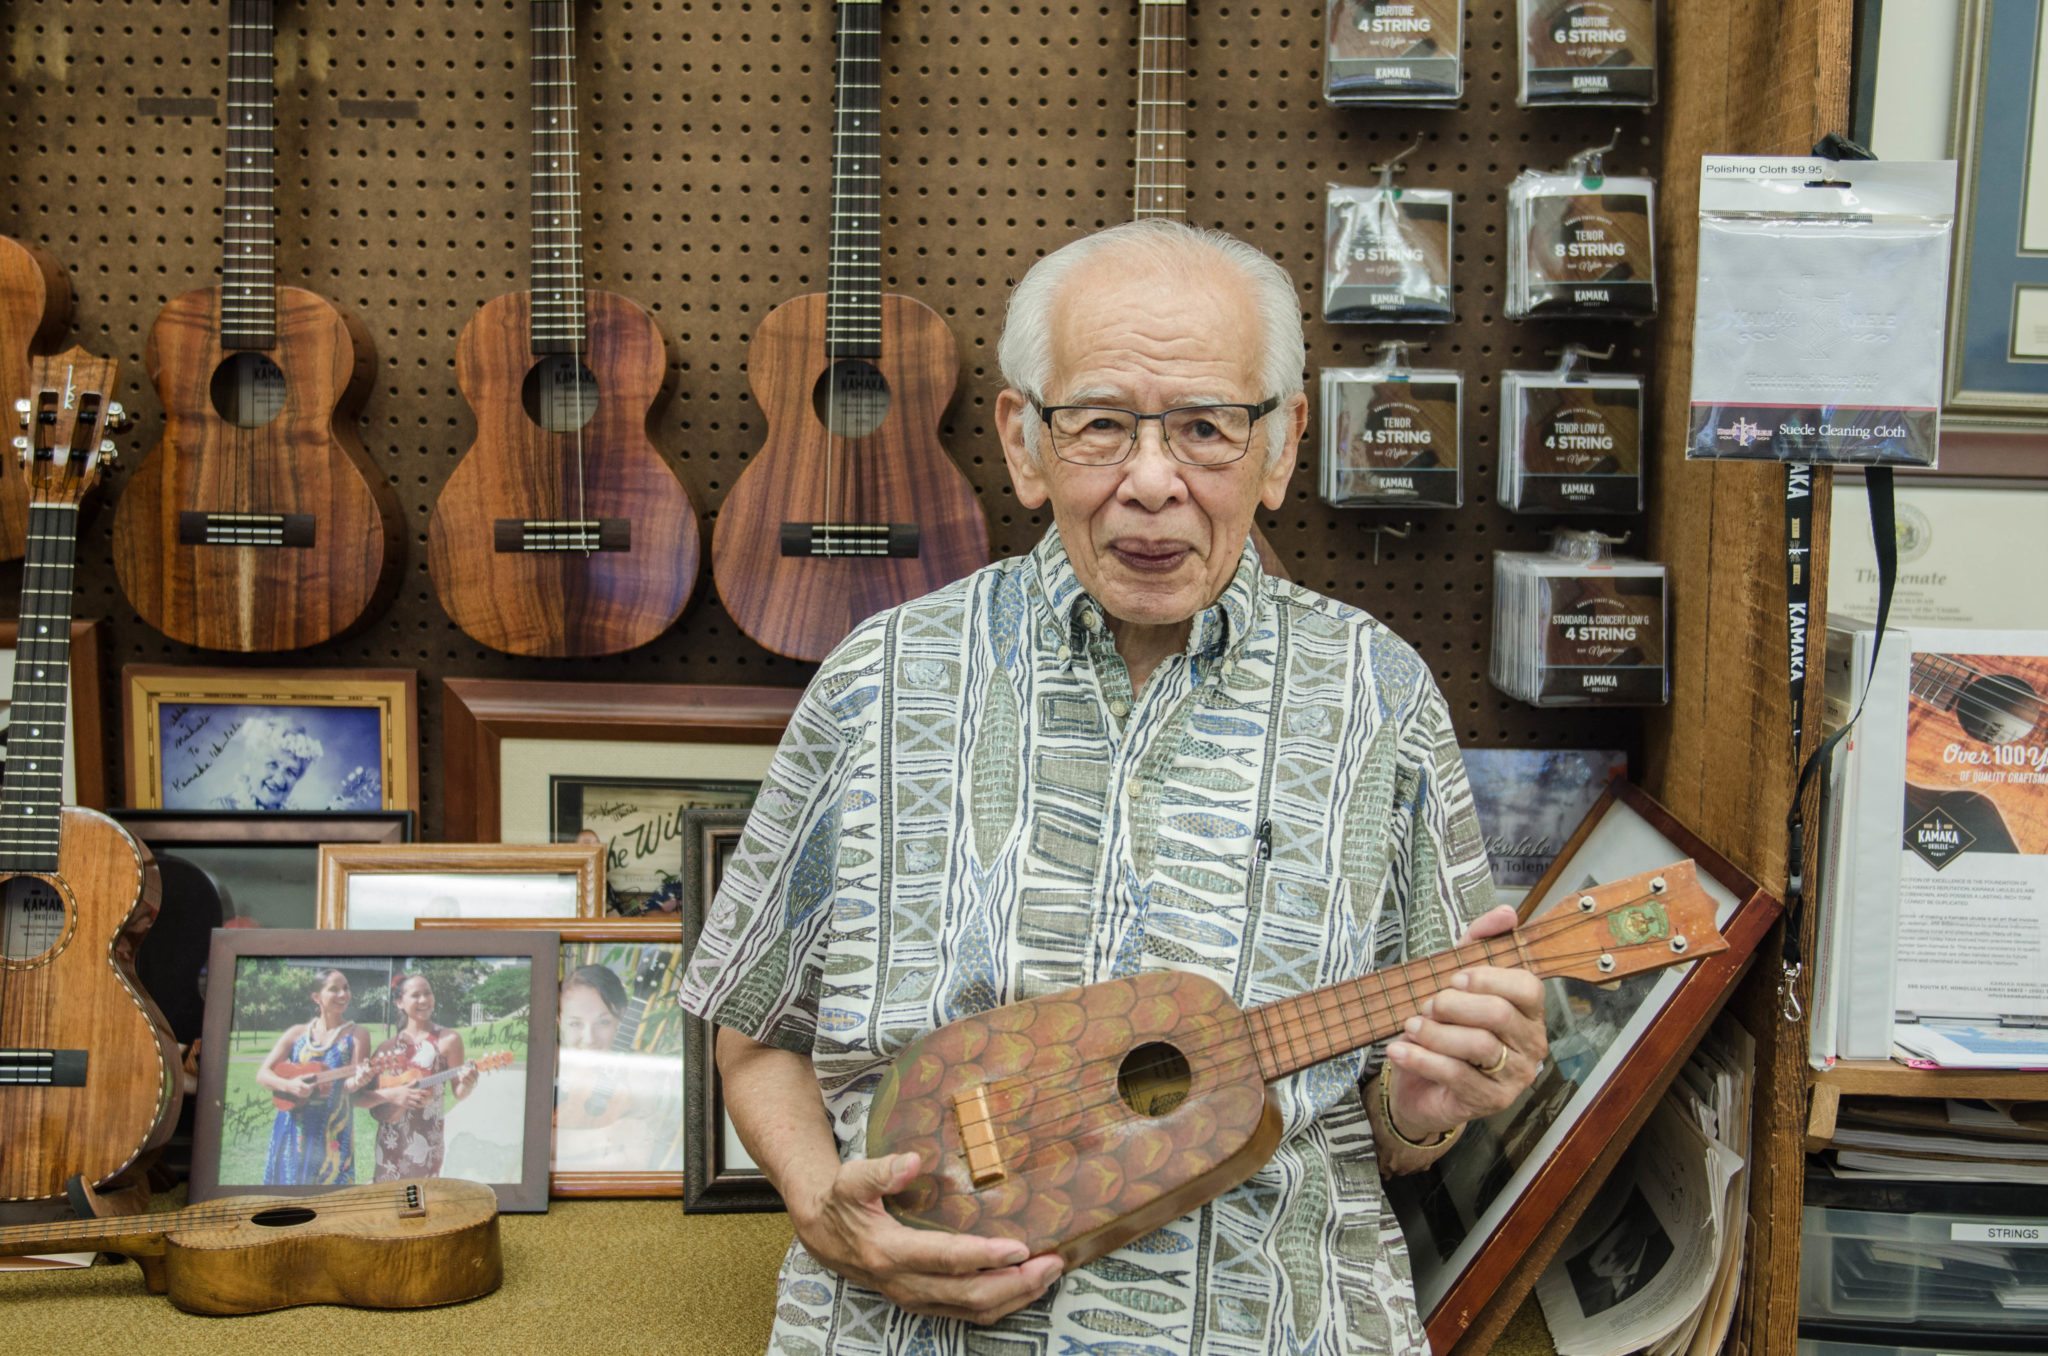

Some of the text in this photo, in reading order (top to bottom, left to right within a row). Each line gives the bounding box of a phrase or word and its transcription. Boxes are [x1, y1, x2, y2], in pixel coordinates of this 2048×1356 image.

[1375, 5, 1415, 17] BARITONE
[1358, 19, 1431, 32] 4 STRING
[1554, 29, 1627, 43] 6 STRING
[1375, 67, 1411, 79] KAMAKA
[1572, 76, 1609, 88] KAMAKA
[1706, 165, 1822, 175] Polishing Cloth $9.95
[1575, 230, 1604, 241] TENOR
[1354, 247, 1424, 261] 6 STRING
[1555, 243, 1625, 257] 8 STRING
[1371, 293, 1405, 305] KAMAKA
[1574, 290, 1609, 302] KAMAKA
[1383, 417, 1411, 428] TENOR
[1554, 422, 1605, 434] TENOR LOW G
[1362, 430, 1431, 444] 4 STRING
[1779, 423, 1815, 436] Suede
[1819, 424, 1871, 439] Cleaning
[1874, 426, 1906, 438] Cloth
[1545, 436, 1613, 450] 4 STRING
[1380, 477, 1413, 488] KAMAKA
[1561, 483, 1595, 495] KAMAKA
[1856, 568, 1880, 584] Th
[1552, 614, 1649, 625] STANDARD & CONCERT LOW G
[1565, 627, 1636, 641] 4 STRING
[1789, 603, 1806, 682] KAMAKA
[1583, 675, 1617, 687] KAMAKA
[1943, 743, 2048, 771] Over 100 Y
[1960, 770, 1972, 781] OF
[1972, 771, 2006, 783] QUALITY
[1918, 830, 1959, 844] KAMAKA
[1988, 1228, 2039, 1239] STRINGS
